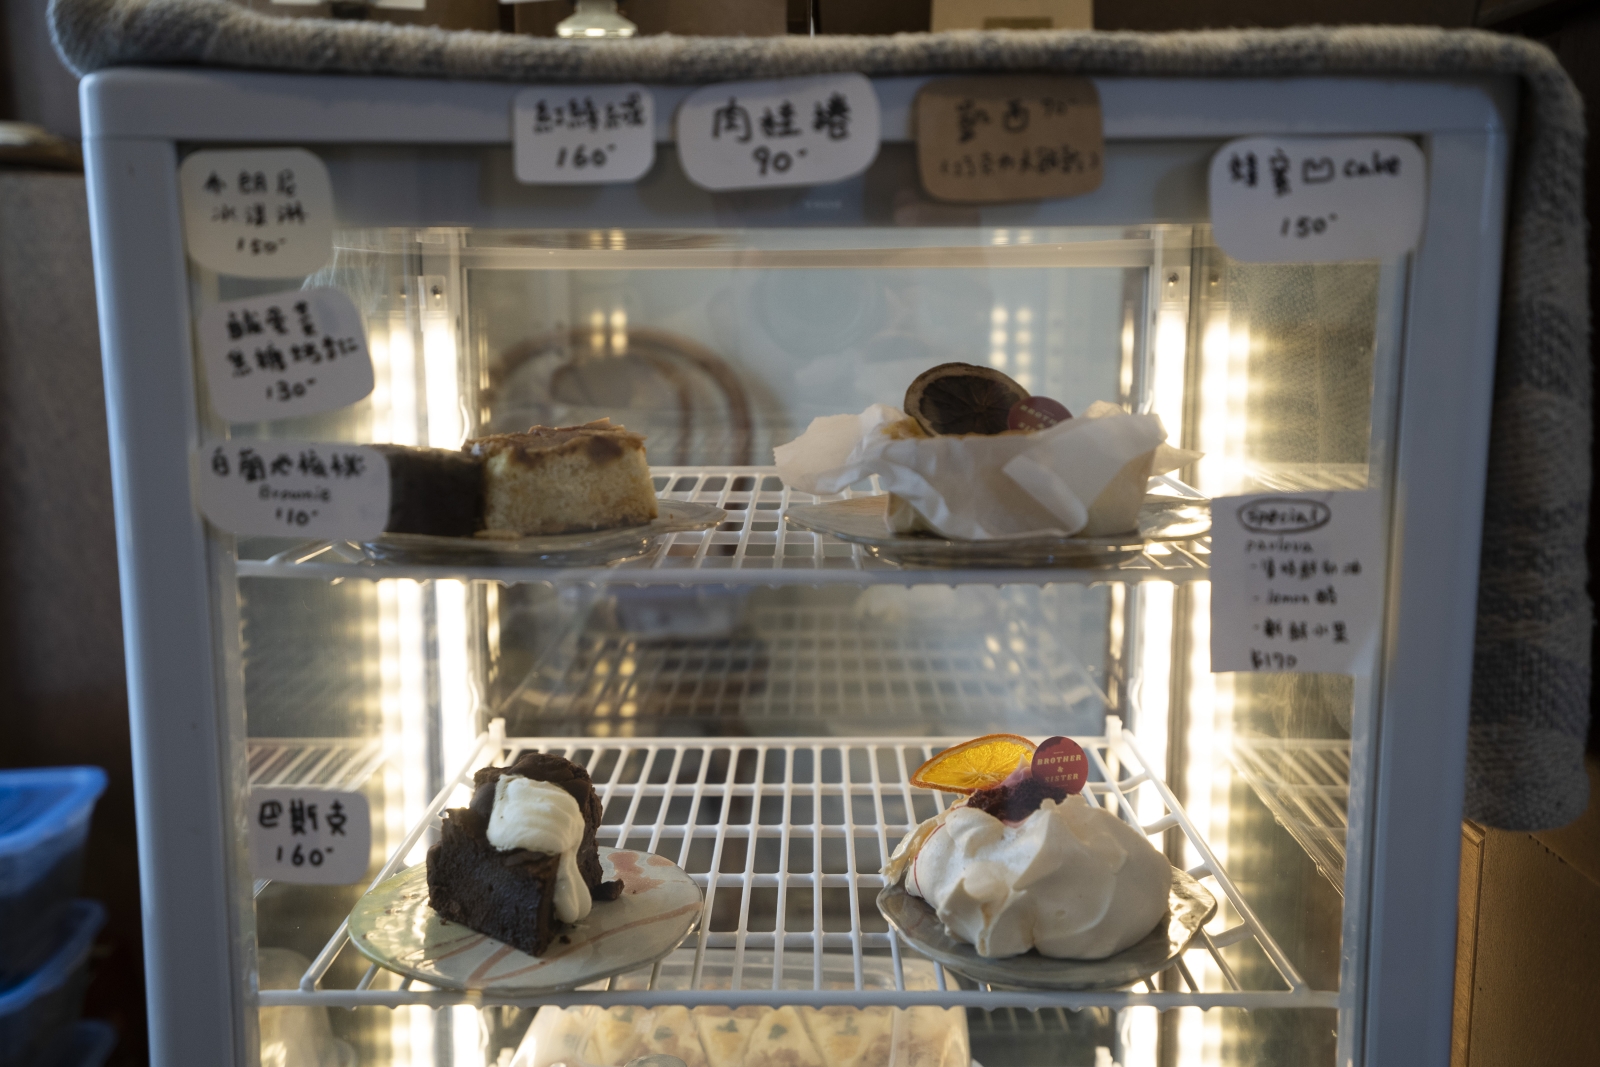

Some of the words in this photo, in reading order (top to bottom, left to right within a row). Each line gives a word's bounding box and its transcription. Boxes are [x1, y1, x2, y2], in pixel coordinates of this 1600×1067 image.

[1037, 754, 1082, 766] BROTHER
[1057, 765, 1064, 773] &
[1044, 773, 1079, 783] SISTER
[258, 799, 347, 836] 巴斯克
